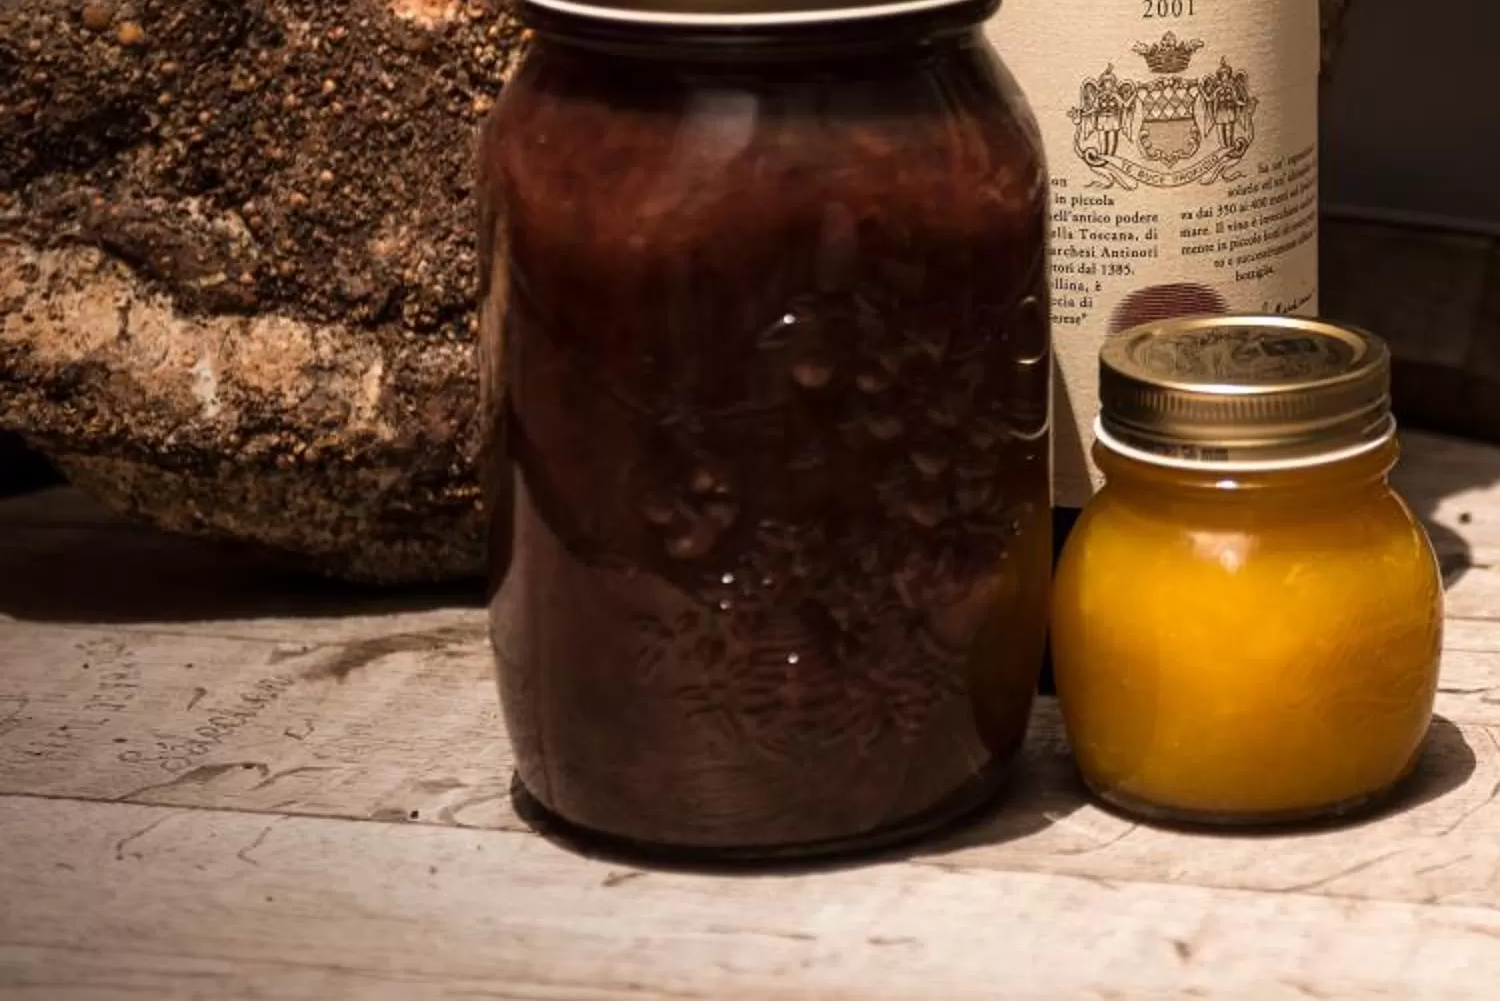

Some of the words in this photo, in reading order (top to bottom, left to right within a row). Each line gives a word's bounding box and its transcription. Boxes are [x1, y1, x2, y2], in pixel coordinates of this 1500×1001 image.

[1050, 178, 1067, 187] on
[1054, 192, 1066, 204] in
[1071, 193, 1114, 207] piccola
[1217, 203, 1236, 216] 350
[1115, 210, 1158, 226] podere
[1050, 226, 1072, 239] ella
[1078, 228, 1139, 241] Toscana,
[1145, 226, 1158, 239] di
[1047, 244, 1094, 257] archesi
[1100, 244, 1158, 258] Antinori
[1051, 262, 1074, 273] tori
[1077, 261, 1096, 274] dal
[1101, 263, 1134, 275] 1385.
[1079, 295, 1092, 307] di
